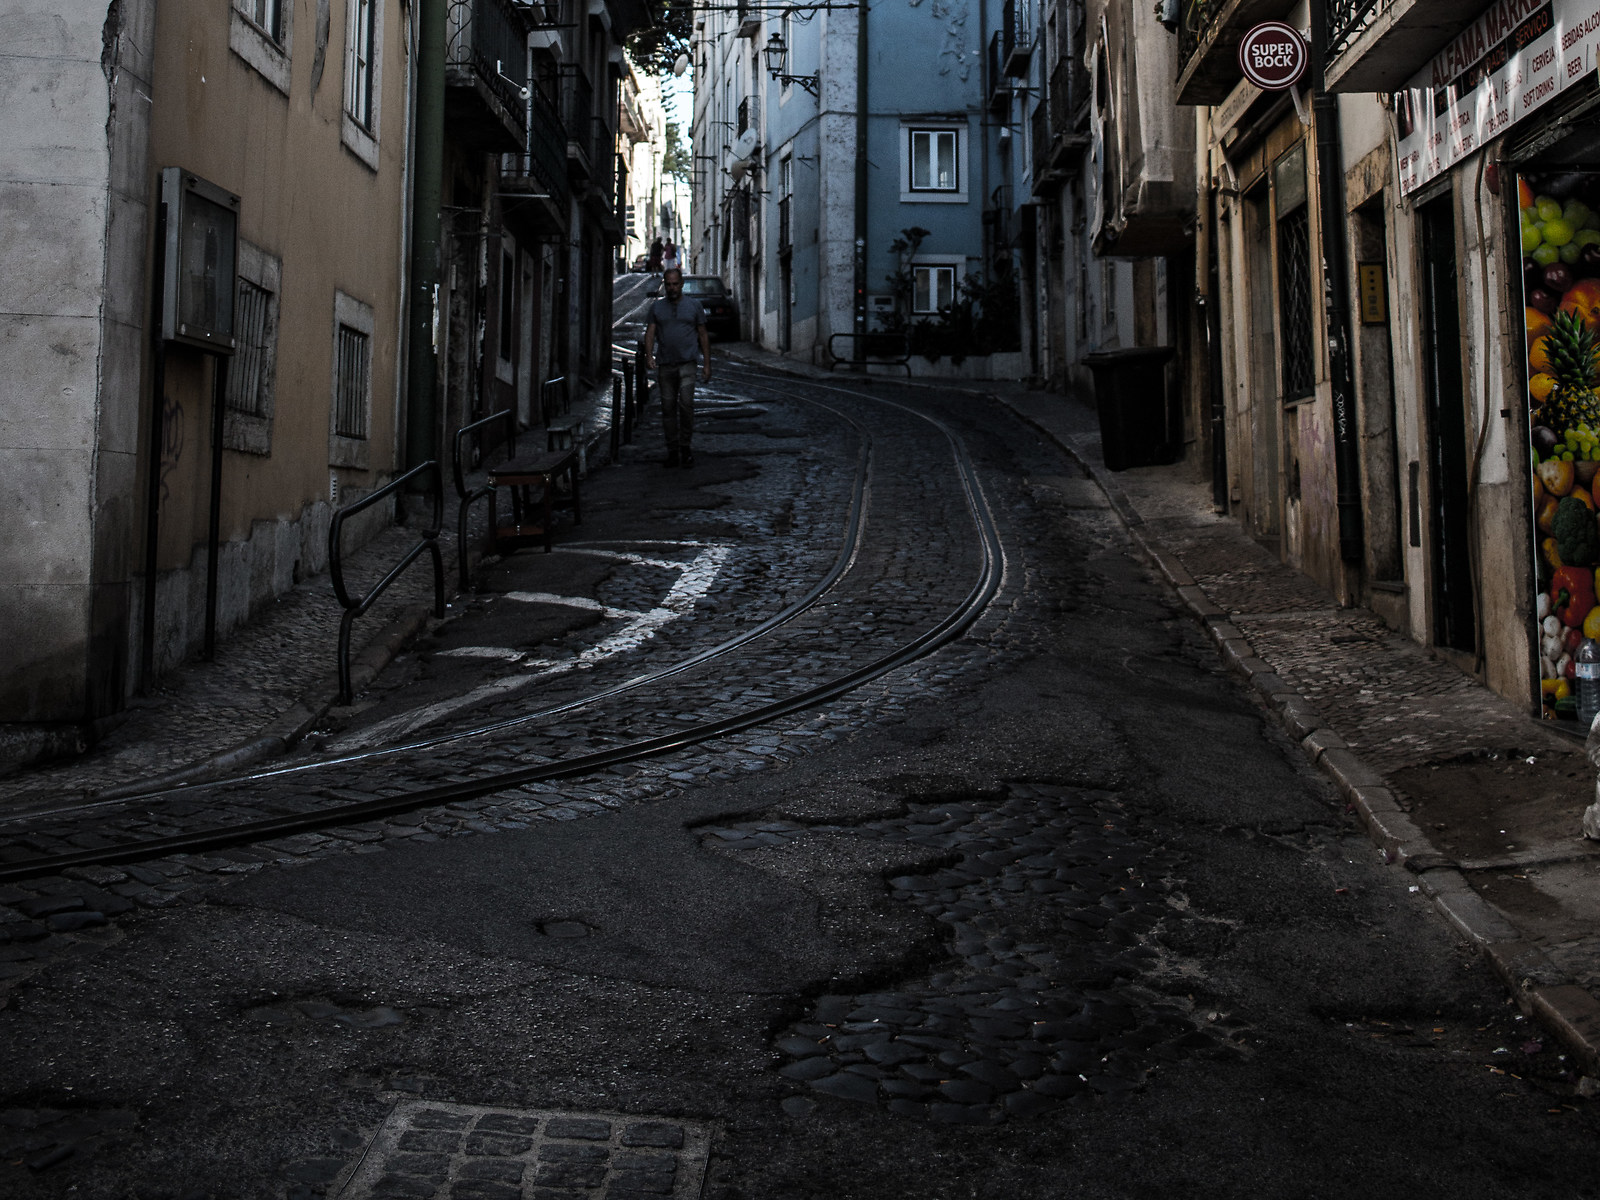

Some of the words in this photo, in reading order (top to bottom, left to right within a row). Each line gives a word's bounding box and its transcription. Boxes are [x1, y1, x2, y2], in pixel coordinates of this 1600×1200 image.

[1251, 43, 1294, 56] SUPER
[1431, 23, 1486, 89] ALFAMA
[1532, 46, 1555, 73] CERVEJA
[1561, 23, 1584, 51] BEBIDAS
[1255, 55, 1293, 68] BOCK
[1567, 56, 1583, 79] BEER
